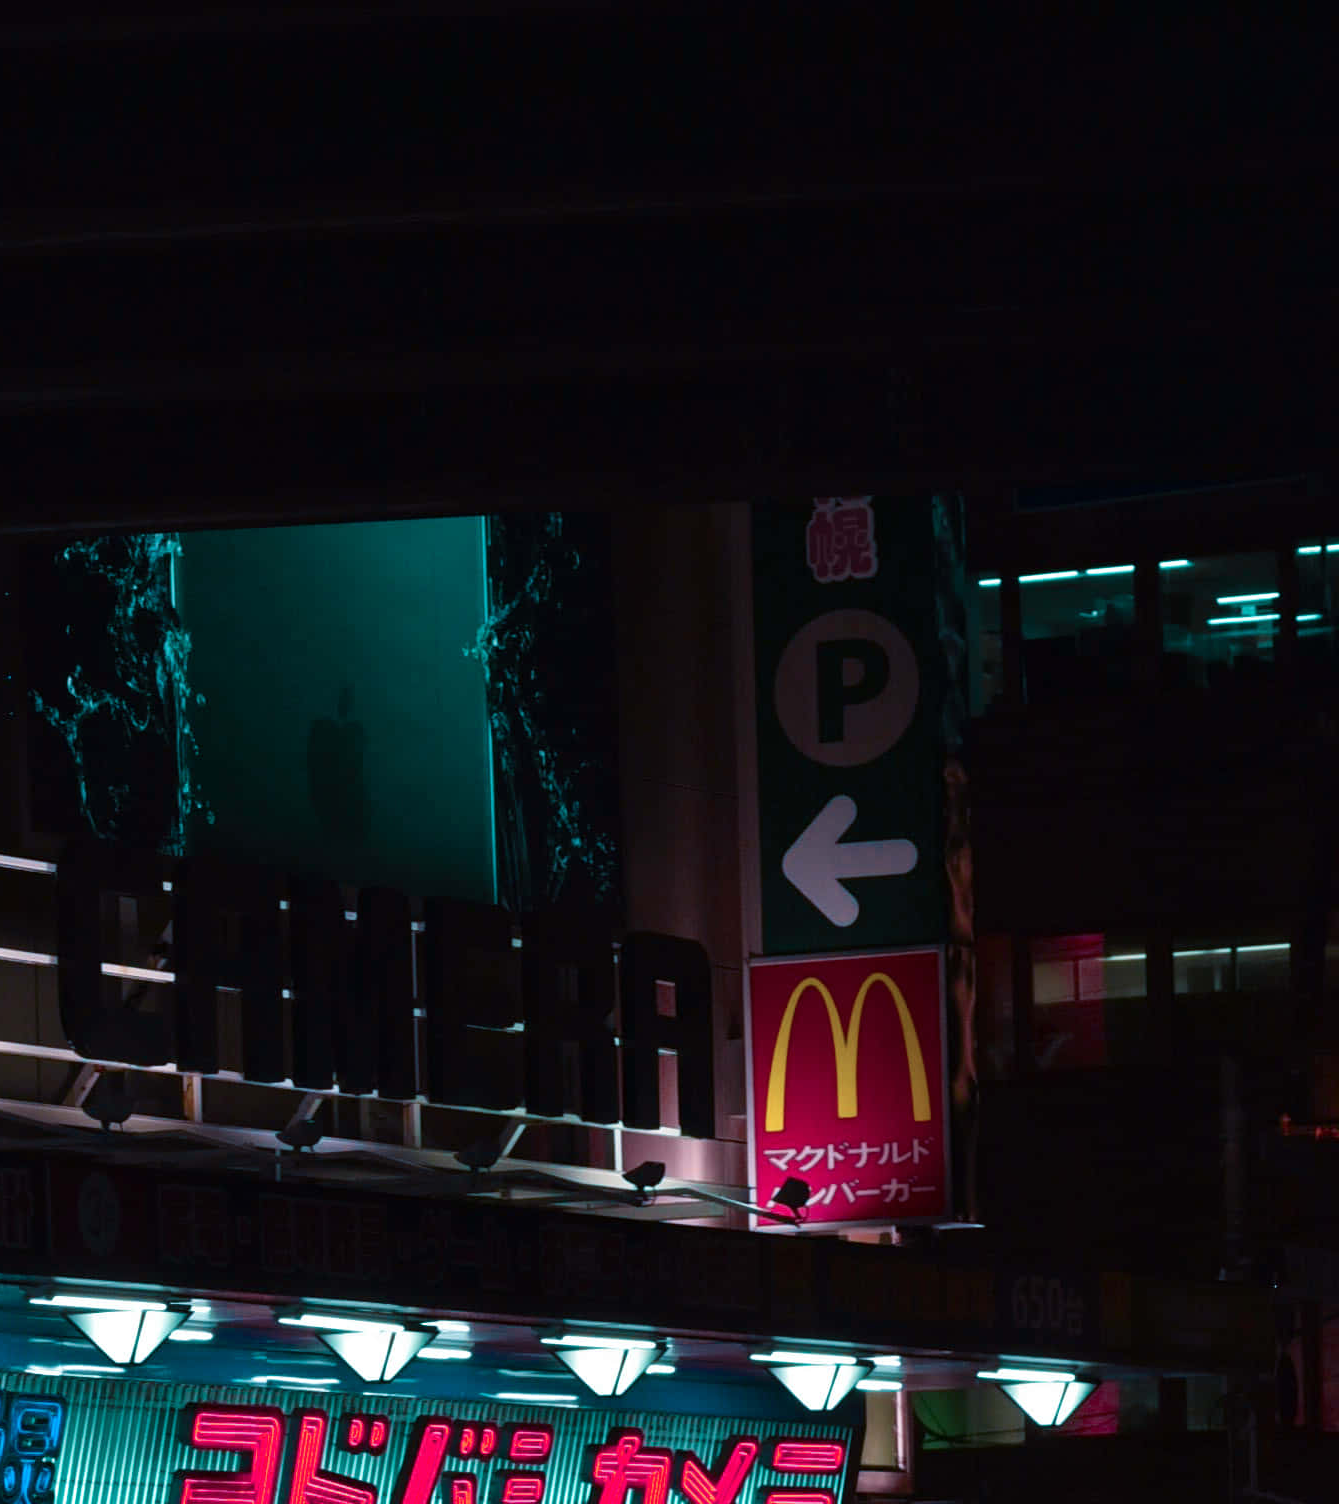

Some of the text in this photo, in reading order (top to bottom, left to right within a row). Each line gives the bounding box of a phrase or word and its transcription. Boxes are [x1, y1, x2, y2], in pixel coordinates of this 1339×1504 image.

[805, 495, 879, 583] 幌
[817, 638, 890, 744] P
[57, 836, 714, 1137] CAMERA
[763, 1136, 935, 1173] マクドナルド
